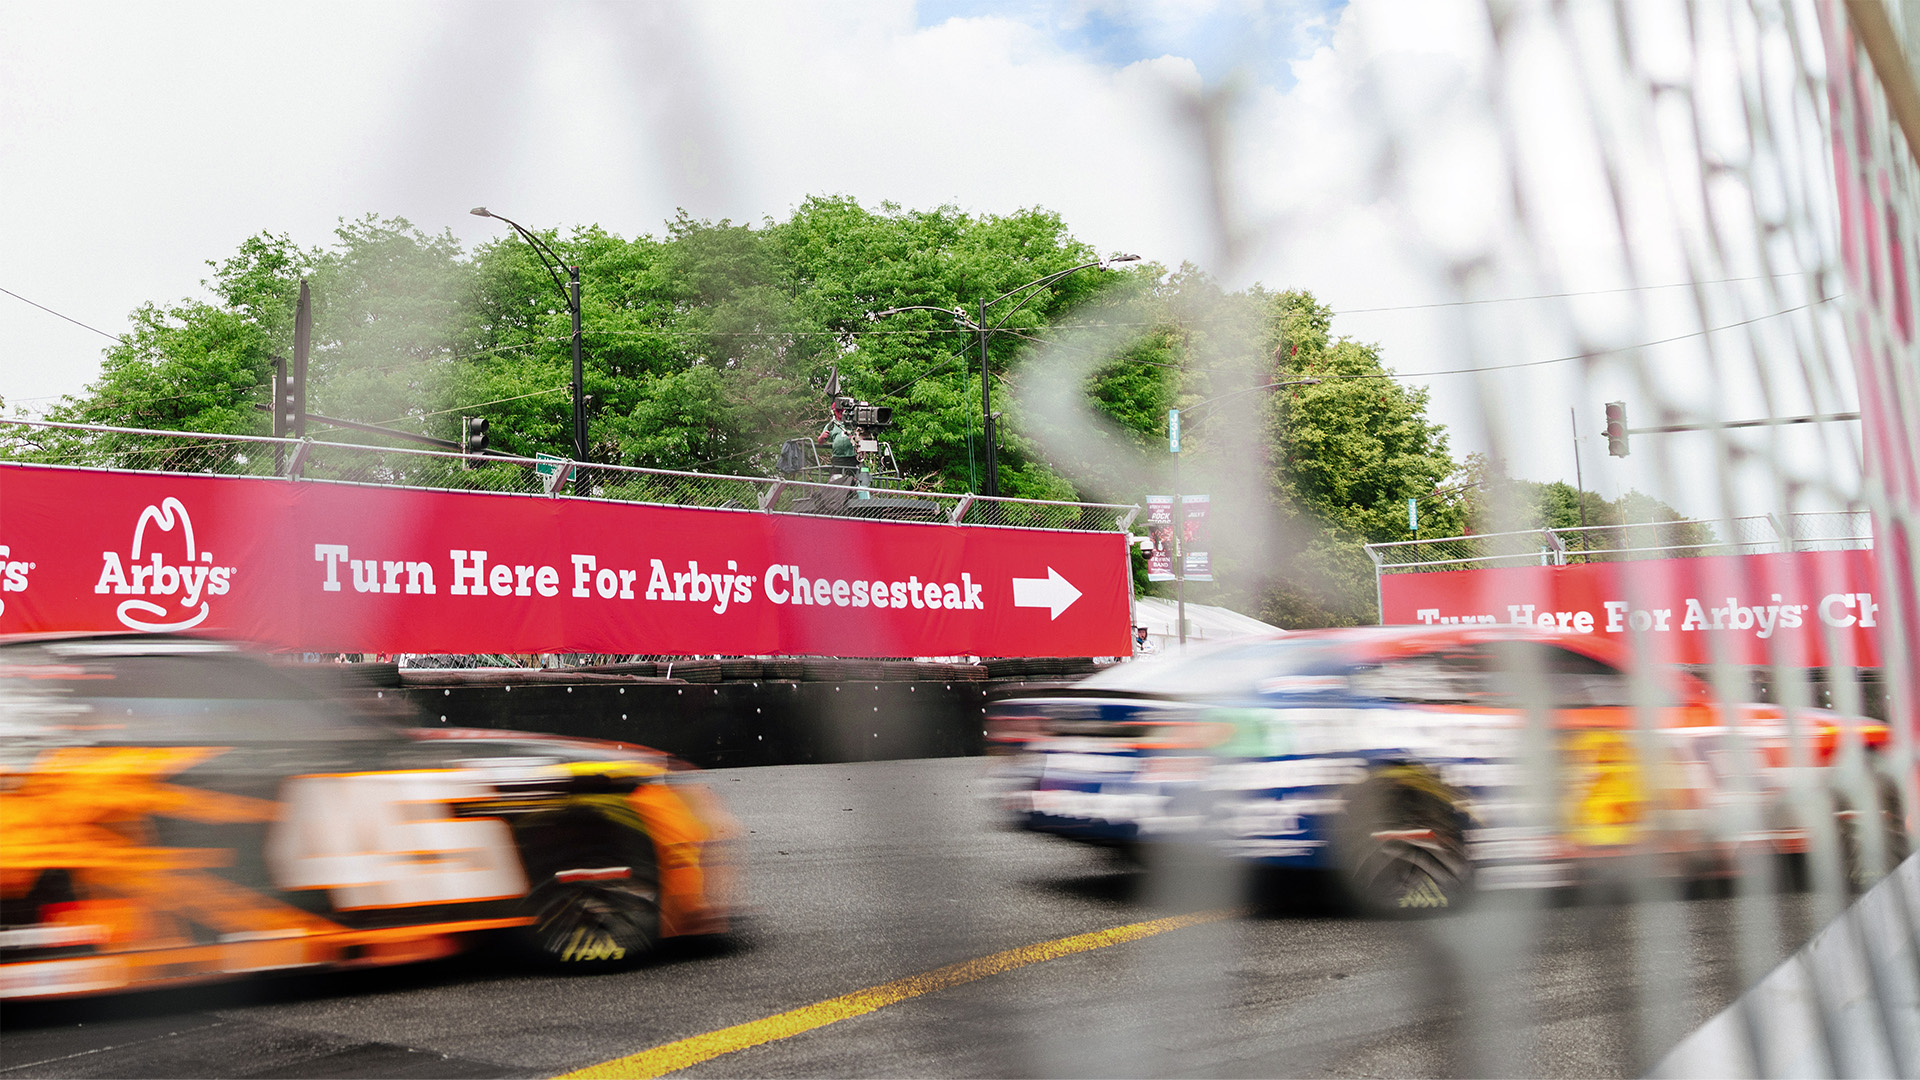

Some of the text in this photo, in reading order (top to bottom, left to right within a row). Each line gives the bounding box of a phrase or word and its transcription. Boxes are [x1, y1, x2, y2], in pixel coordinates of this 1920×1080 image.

[314, 543, 437, 594] Turn
[450, 549, 559, 598] Here
[571, 554, 636, 600] For
[764, 563, 984, 610] Cheesesteak
[1507, 604, 1594, 633] Here
[1603, 601, 1671, 632] For
